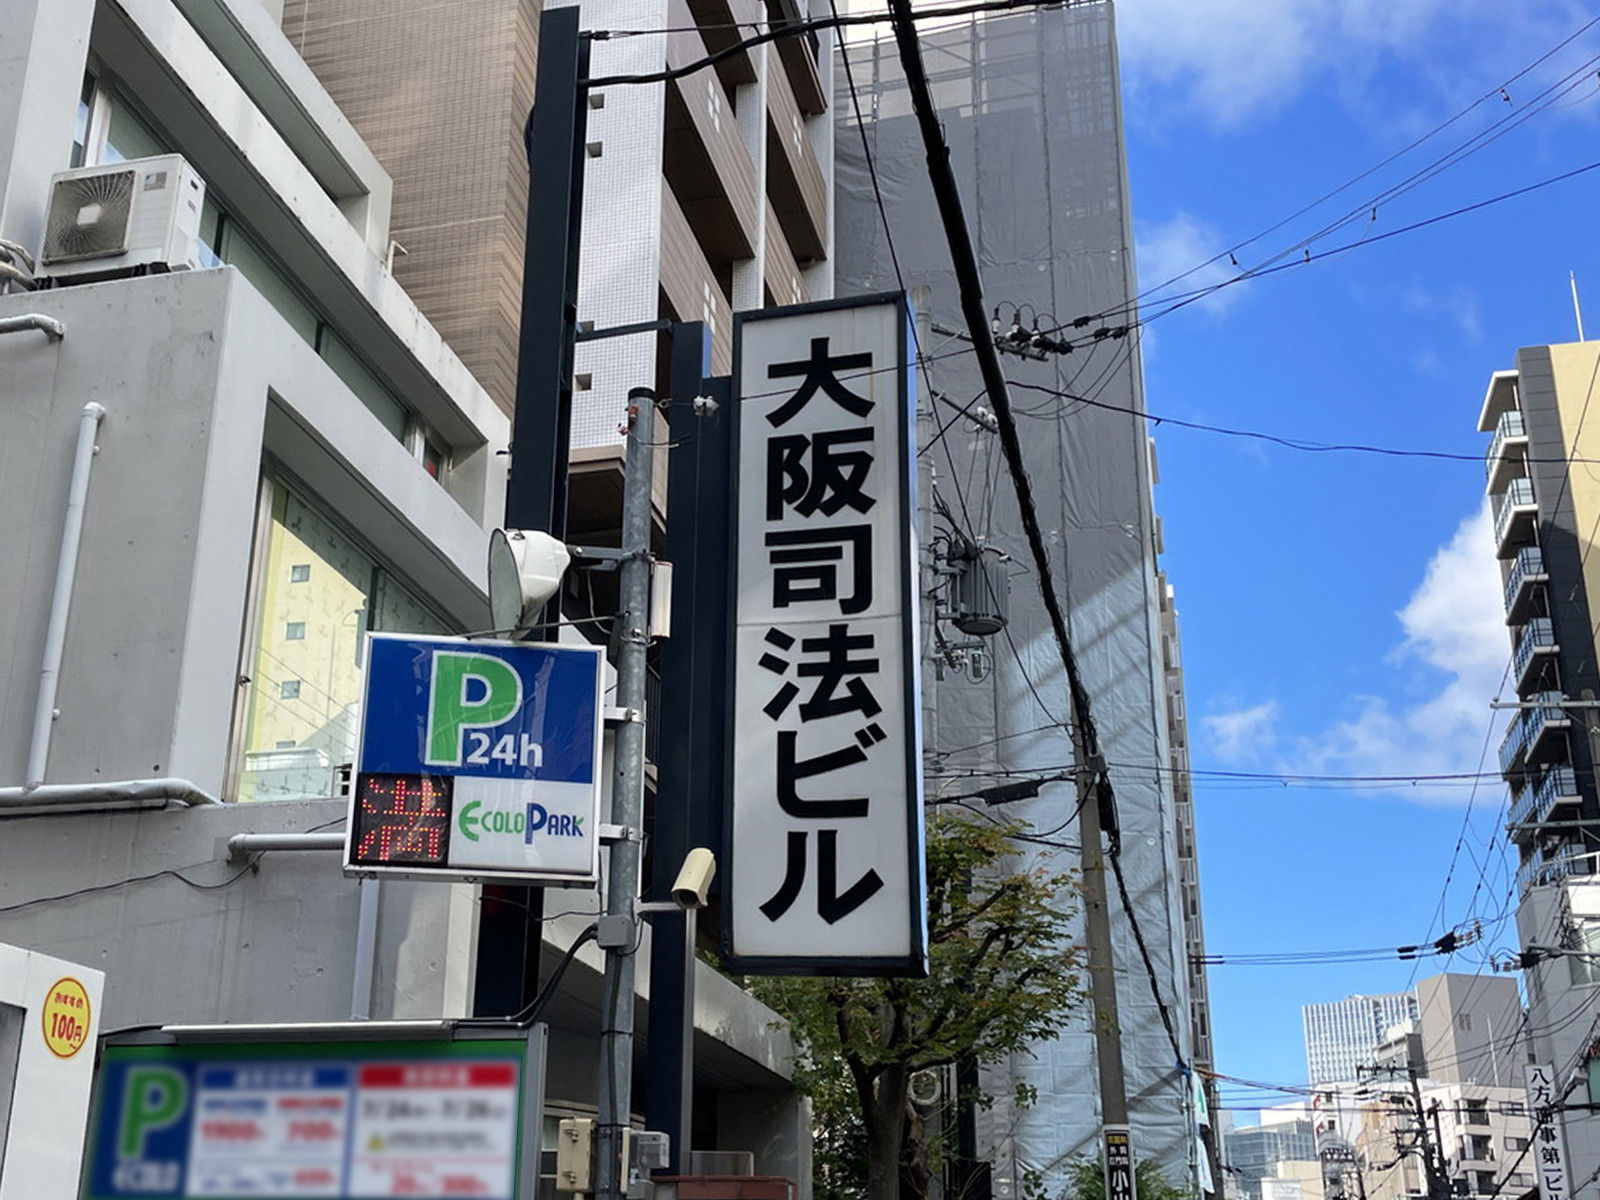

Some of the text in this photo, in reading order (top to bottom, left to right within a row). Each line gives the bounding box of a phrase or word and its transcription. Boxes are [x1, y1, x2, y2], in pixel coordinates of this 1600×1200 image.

[758, 336, 887, 925] 大阪司法ビル
[424, 650, 524, 767] P
[466, 732, 543, 767] 24h
[1112, 1169, 1130, 1200] 小
